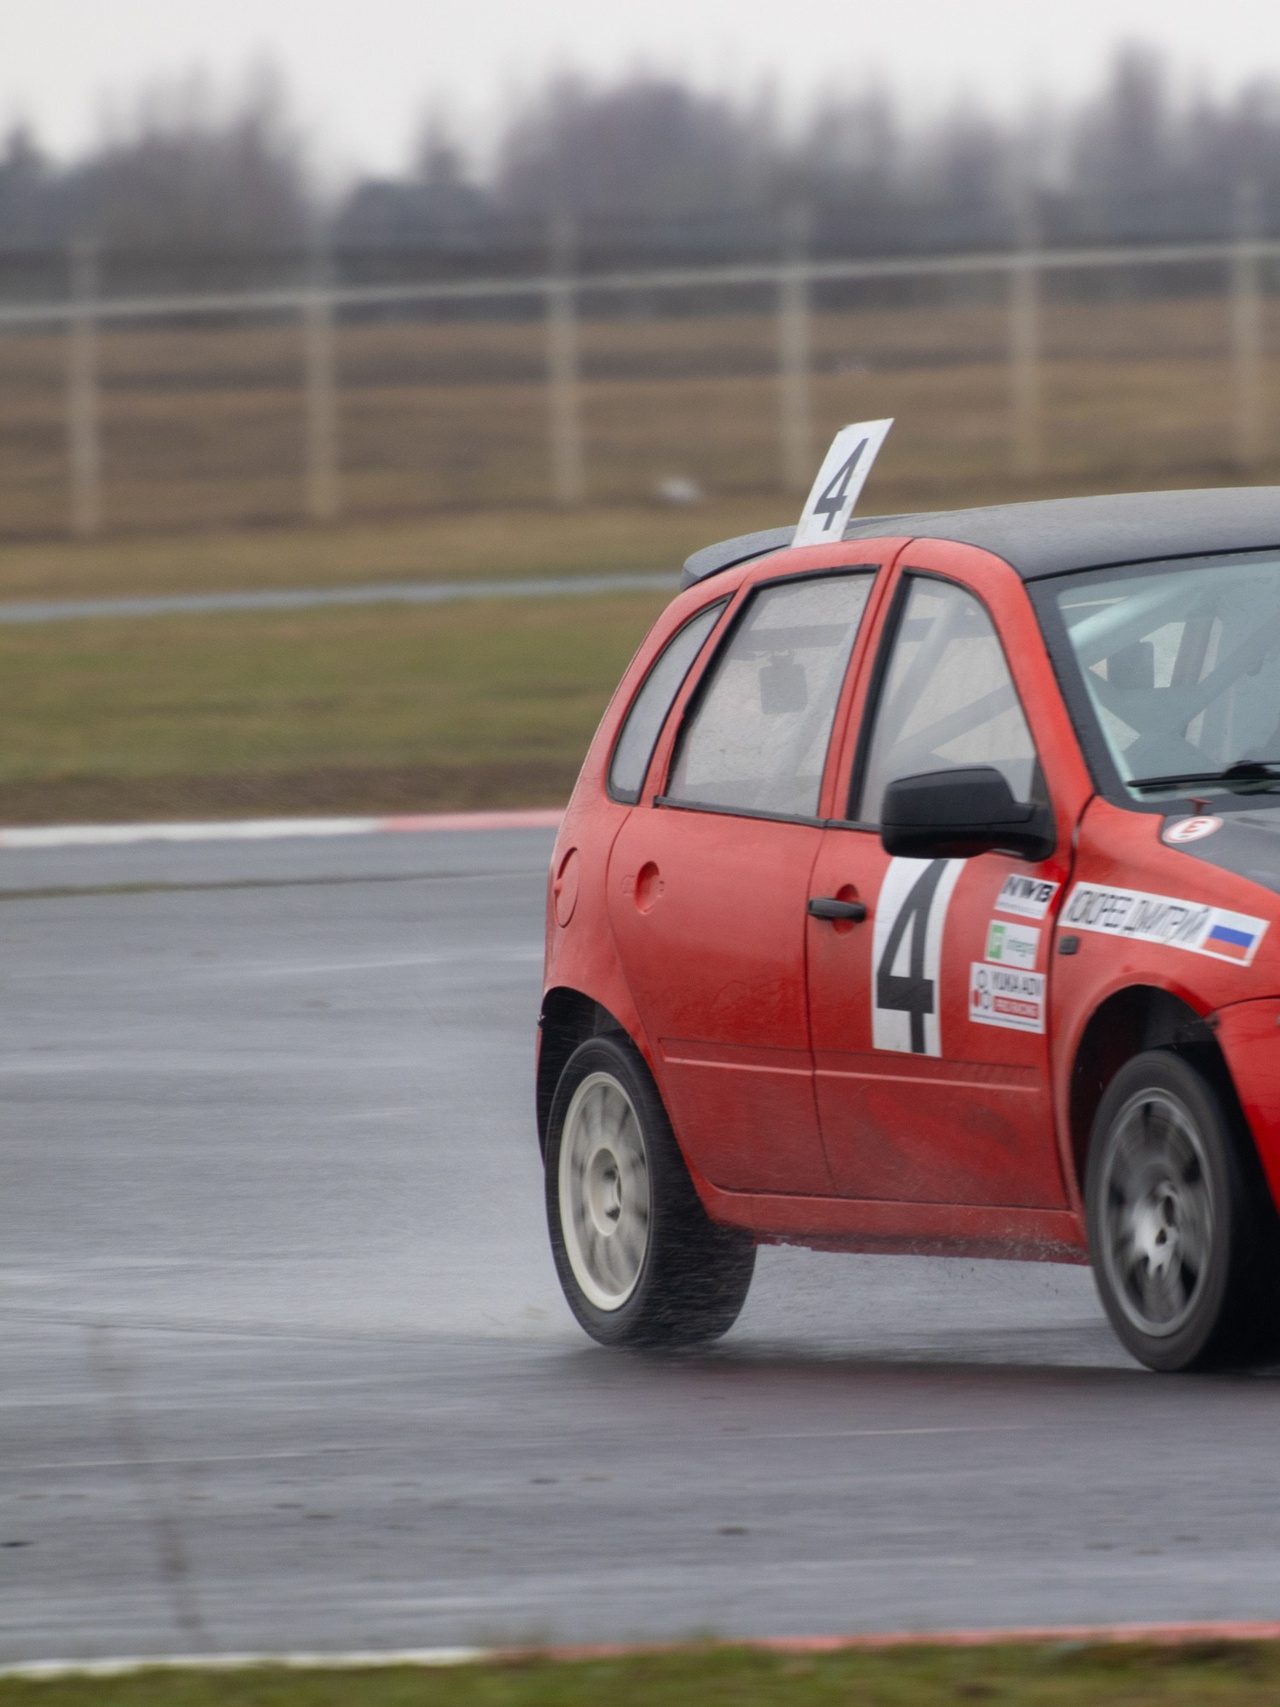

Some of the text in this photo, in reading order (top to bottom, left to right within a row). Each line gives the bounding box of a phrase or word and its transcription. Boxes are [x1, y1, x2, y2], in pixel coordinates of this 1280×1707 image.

[813, 437, 869, 531] 4
[1180, 820, 1208, 834] E
[876, 858, 950, 1054] 4
